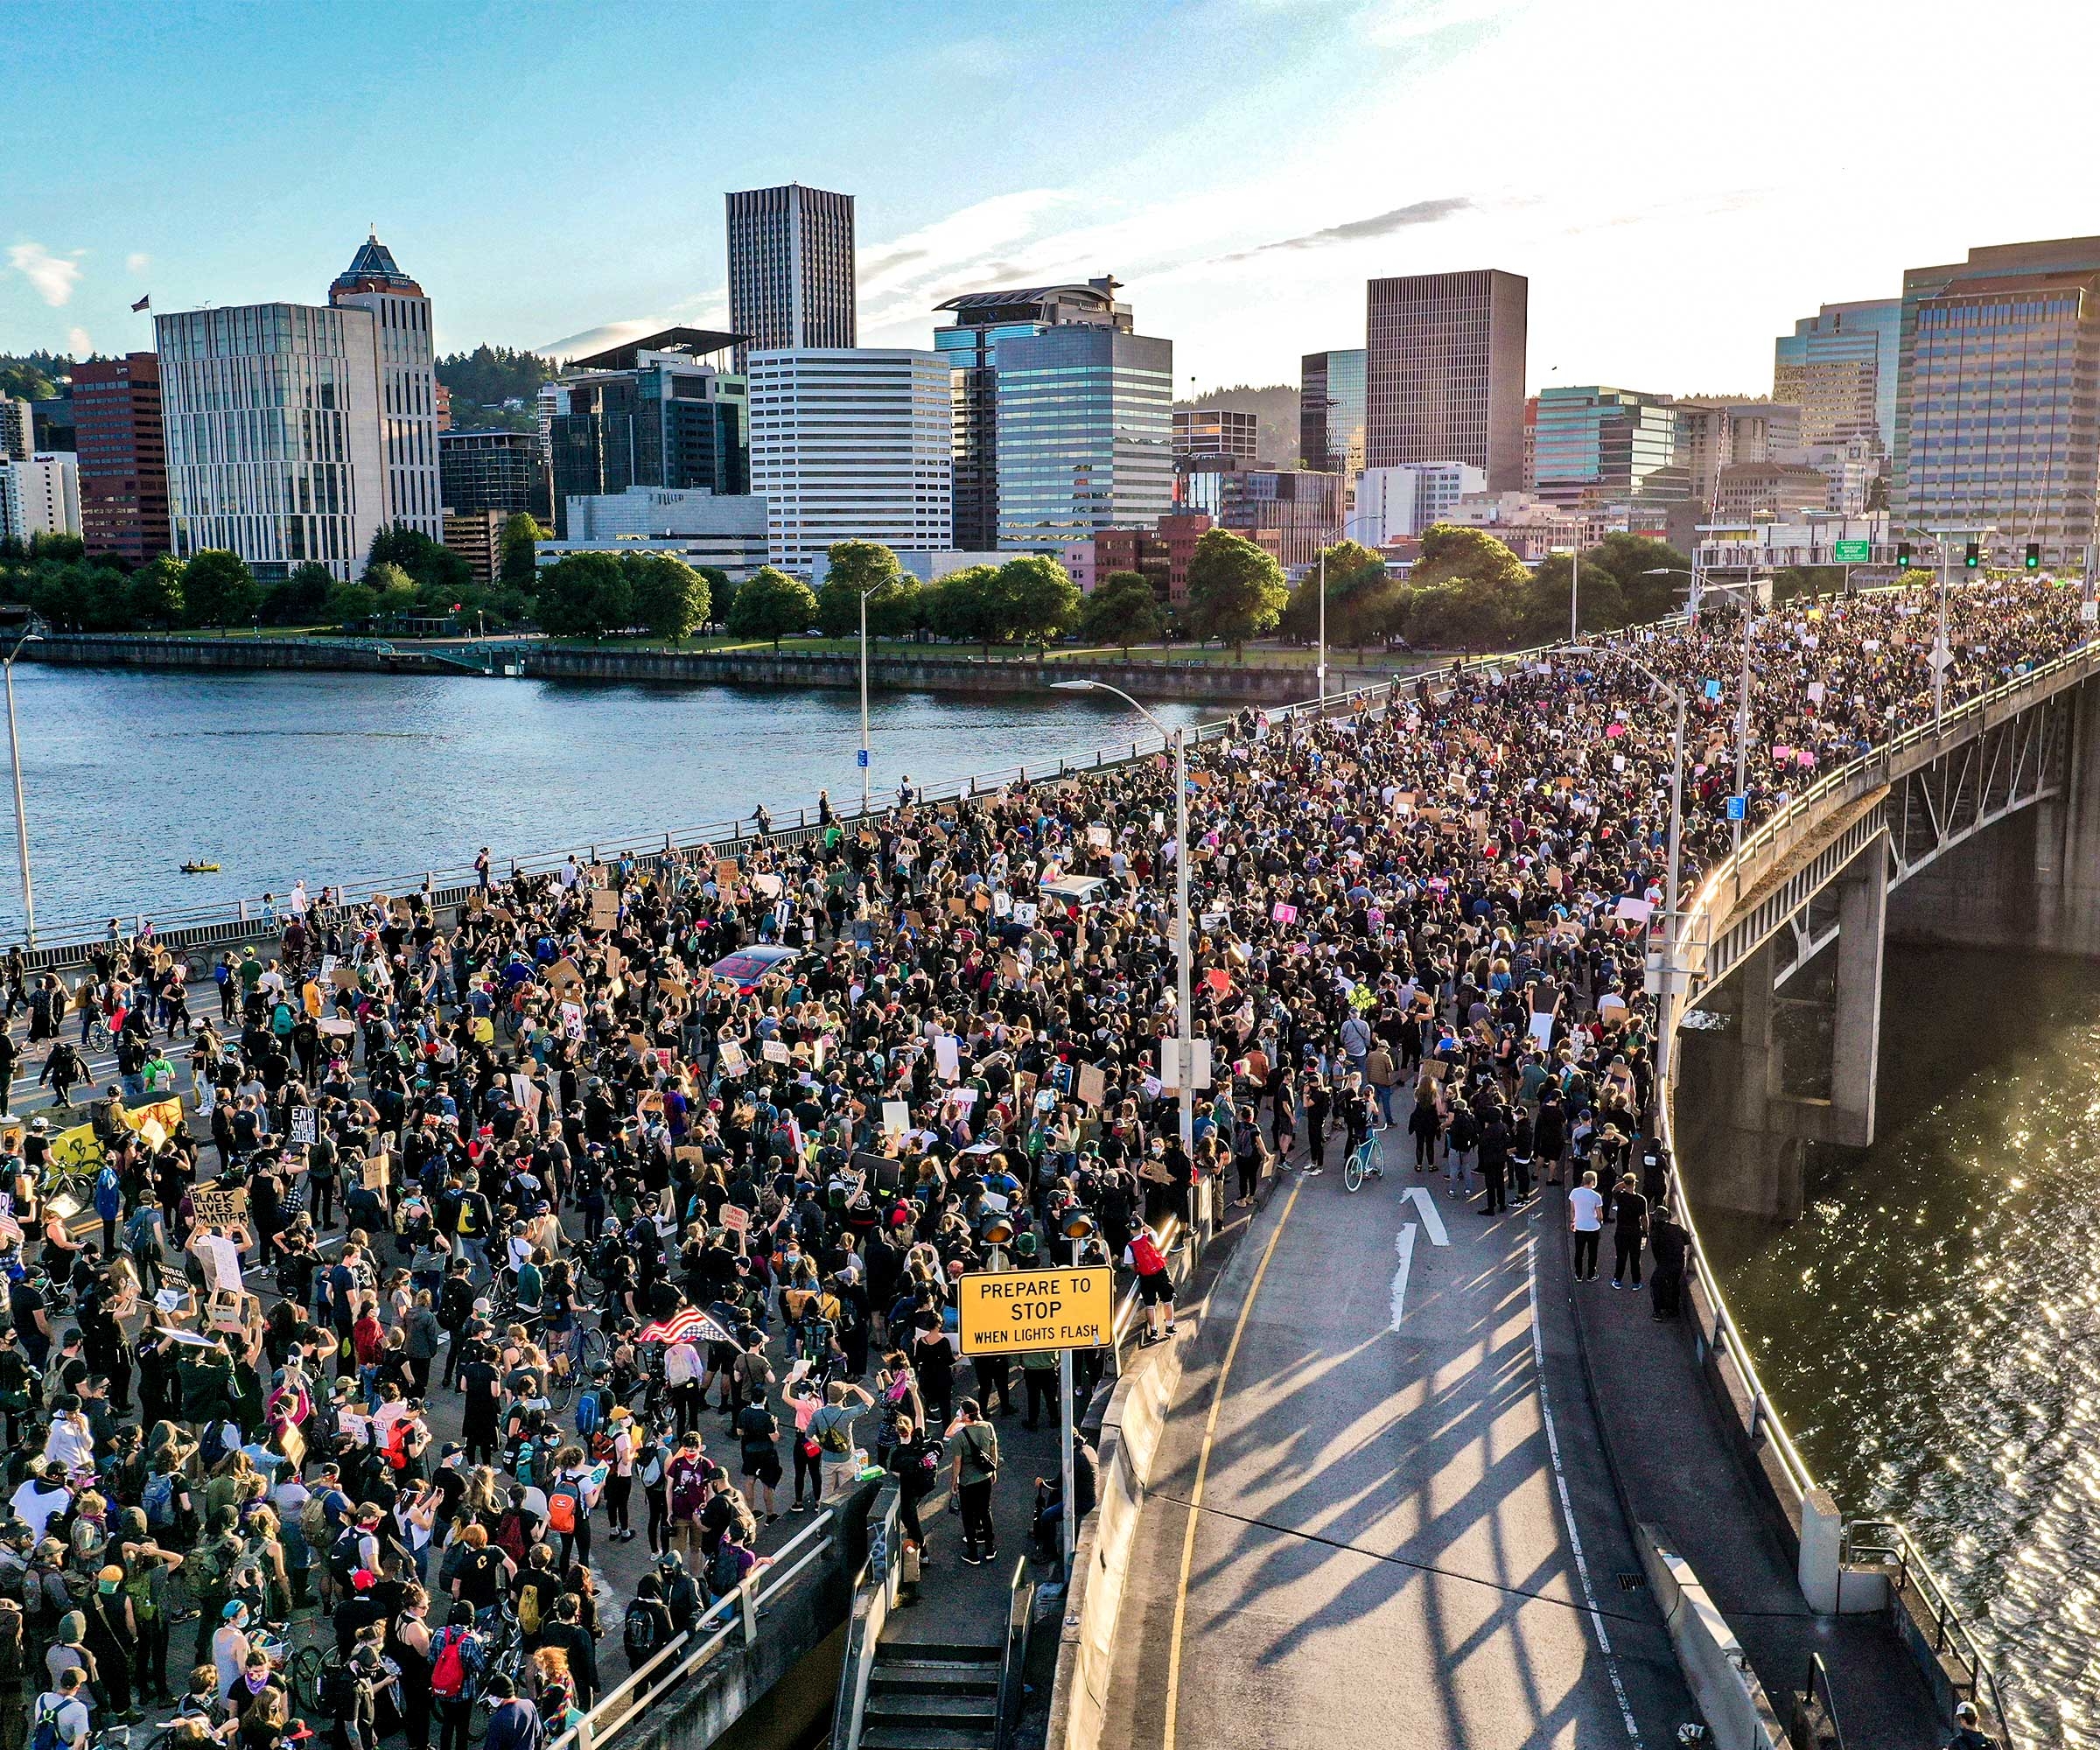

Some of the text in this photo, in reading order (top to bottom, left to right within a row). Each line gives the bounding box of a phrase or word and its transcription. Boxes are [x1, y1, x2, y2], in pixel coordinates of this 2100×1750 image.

[291, 1108, 315, 1121] END
[290, 1120, 316, 1132] WHITE
[290, 1131, 316, 1144] SILENCE
[192, 1192, 235, 1203] BLACK
[194, 1202, 233, 1214] LIVES
[197, 1211, 248, 1224] MATTER
[981, 1278, 1091, 1299] PREPARE TO
[1011, 1301, 1061, 1320] STOP
[974, 1324, 1099, 1344] WHEN LIGHTS FLASH
